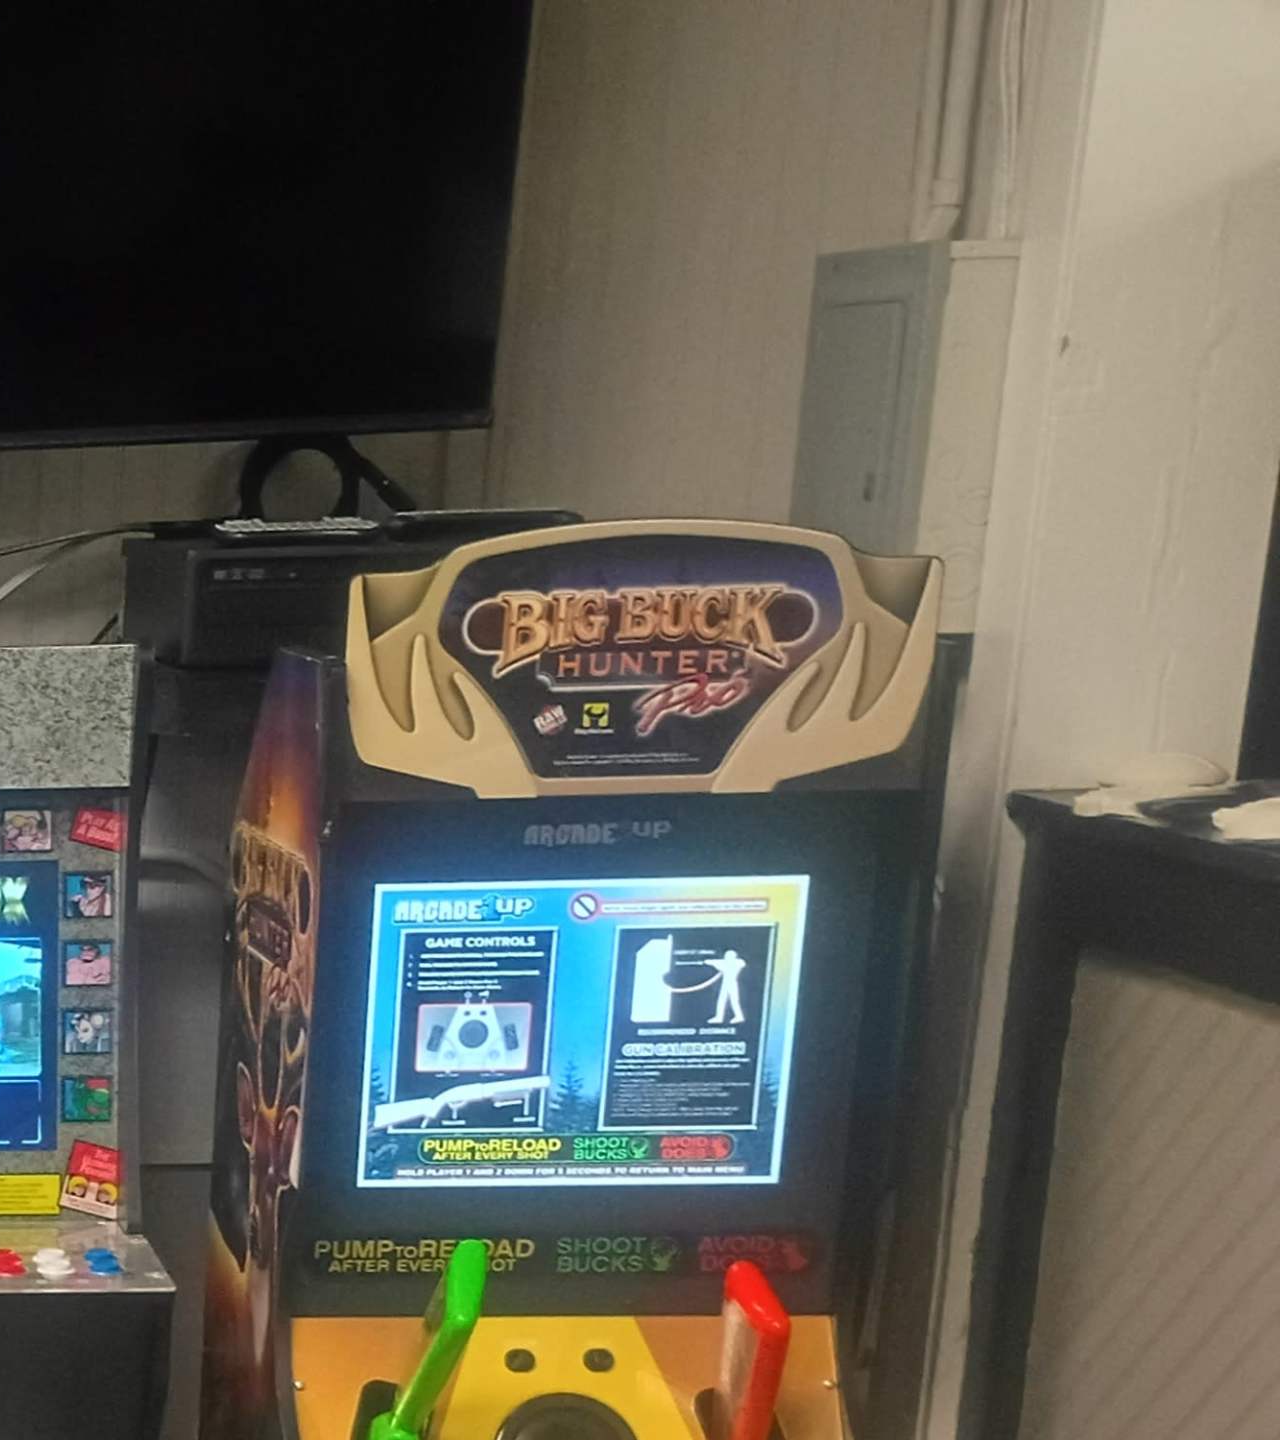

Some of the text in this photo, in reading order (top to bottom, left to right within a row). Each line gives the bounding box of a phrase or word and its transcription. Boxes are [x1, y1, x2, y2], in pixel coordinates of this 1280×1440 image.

[495, 586, 787, 678] BIG BUCK
[557, 652, 730, 676] HUNTER
[425, 936, 536, 948] GAME CONTROLS
[621, 1041, 747, 1057] GUN CALIBRATION
[573, 1138, 628, 1150] SHOOT
[574, 1149, 628, 1161] BUCKS
[557, 1237, 648, 1254] SHOOT
[328, 1258, 446, 1272] AFTER EVER
[556, 1255, 644, 1273] BUCKS
